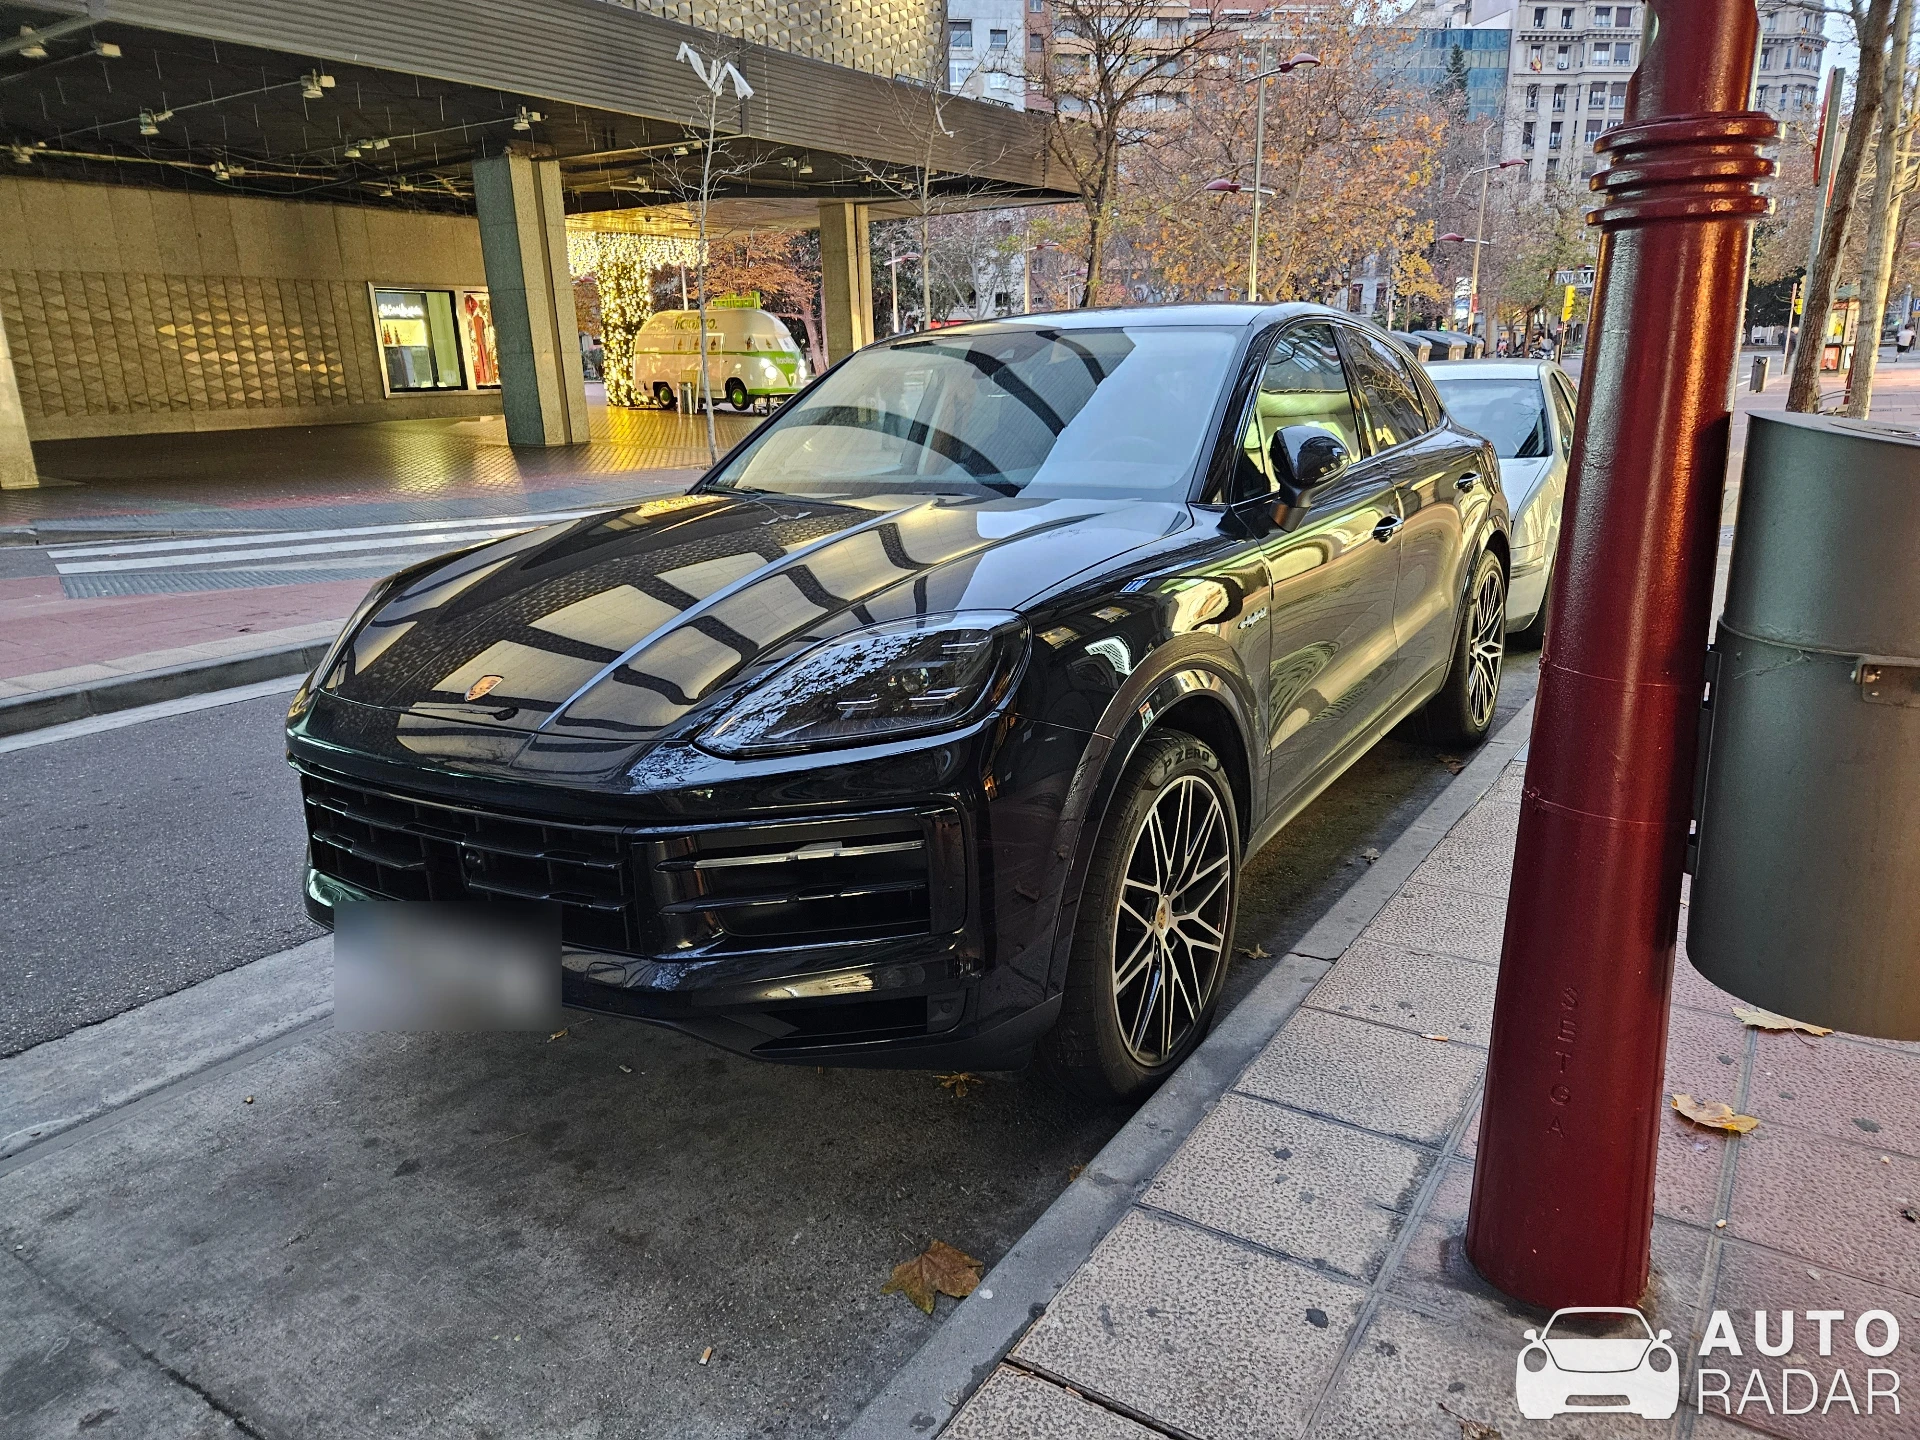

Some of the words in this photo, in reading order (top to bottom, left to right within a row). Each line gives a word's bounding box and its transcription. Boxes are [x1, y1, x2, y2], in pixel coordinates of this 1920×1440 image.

[1163, 757, 1172, 776] P
[1175, 748, 1209, 765] ZERO
[1546, 986, 1581, 1139] SETGA
